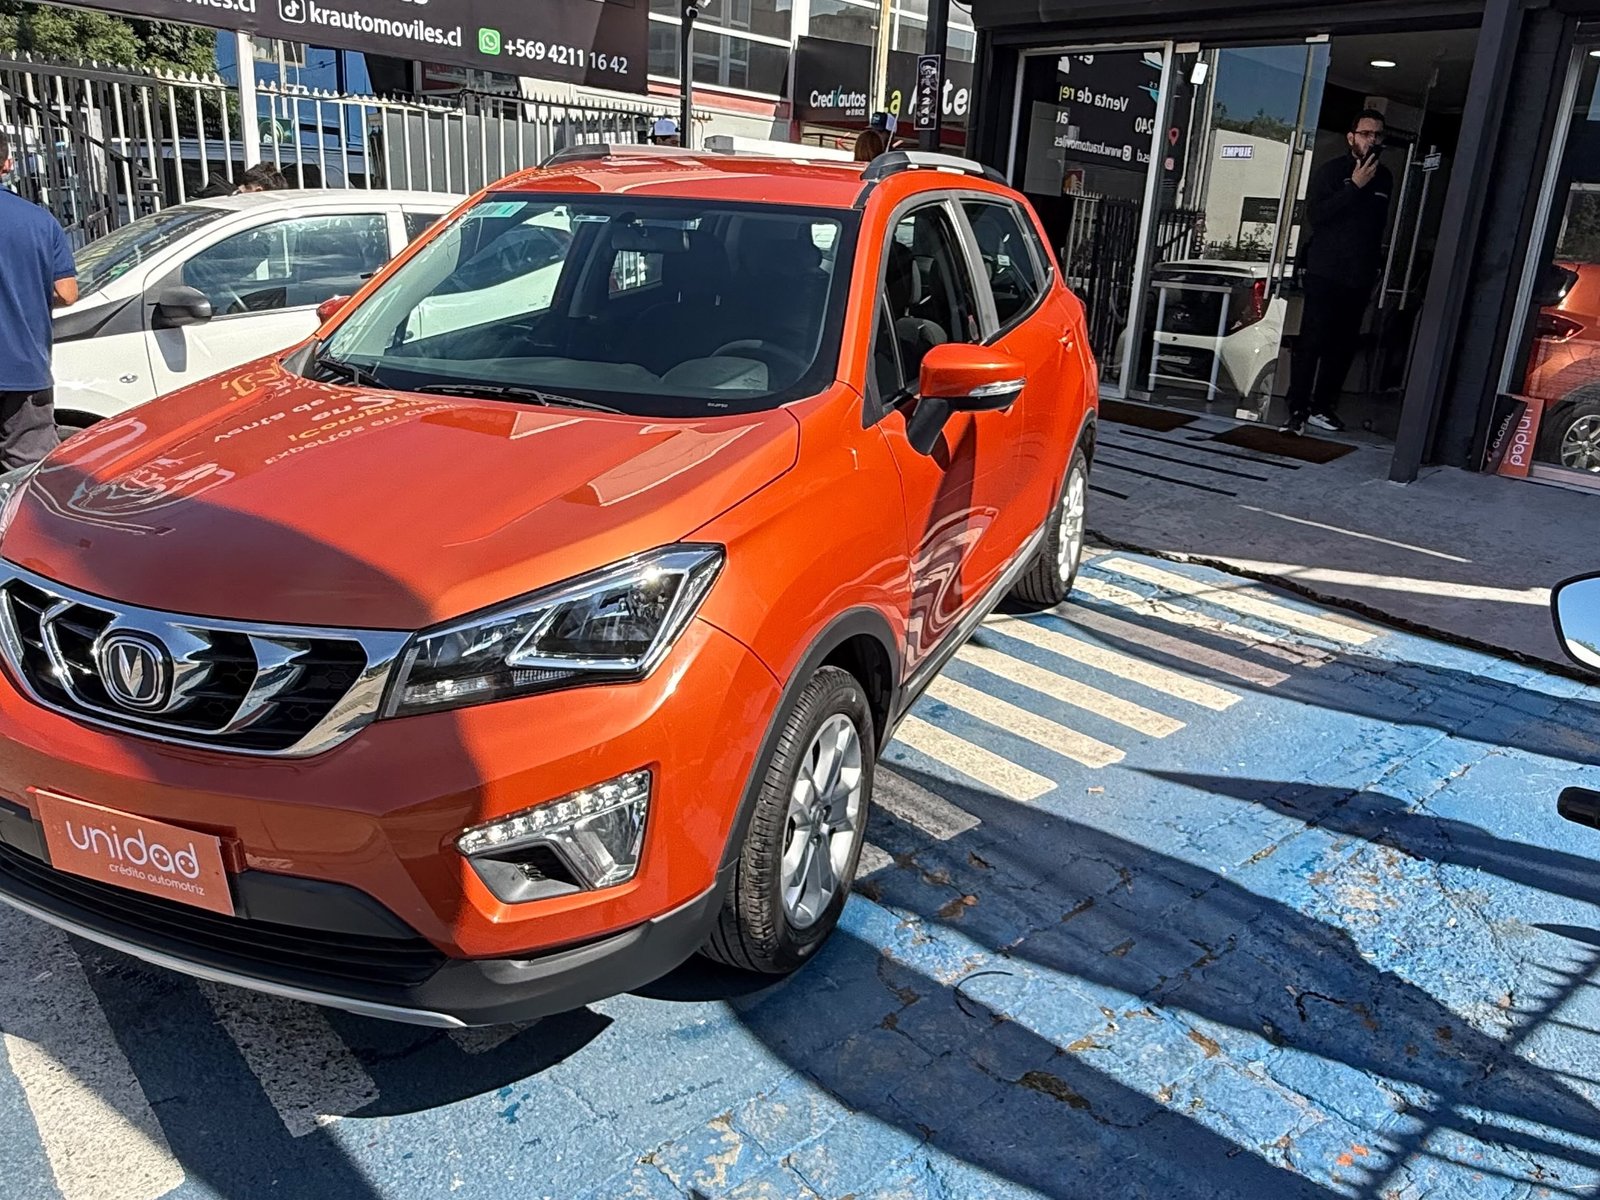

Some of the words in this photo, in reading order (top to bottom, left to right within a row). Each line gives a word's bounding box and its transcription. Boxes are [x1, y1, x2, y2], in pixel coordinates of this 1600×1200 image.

[309, 1, 462, 47] krautomoviles.cl
[504, 38, 545, 60] +569
[547, 44, 584, 67] 4211
[589, 51, 607, 71] 16
[609, 55, 628, 75] 42
[1492, 412, 1514, 449] GLOBAL
[66, 820, 200, 879] unidad
[109, 862, 146, 881] crédito
[147, 872, 205, 896] automotriz
